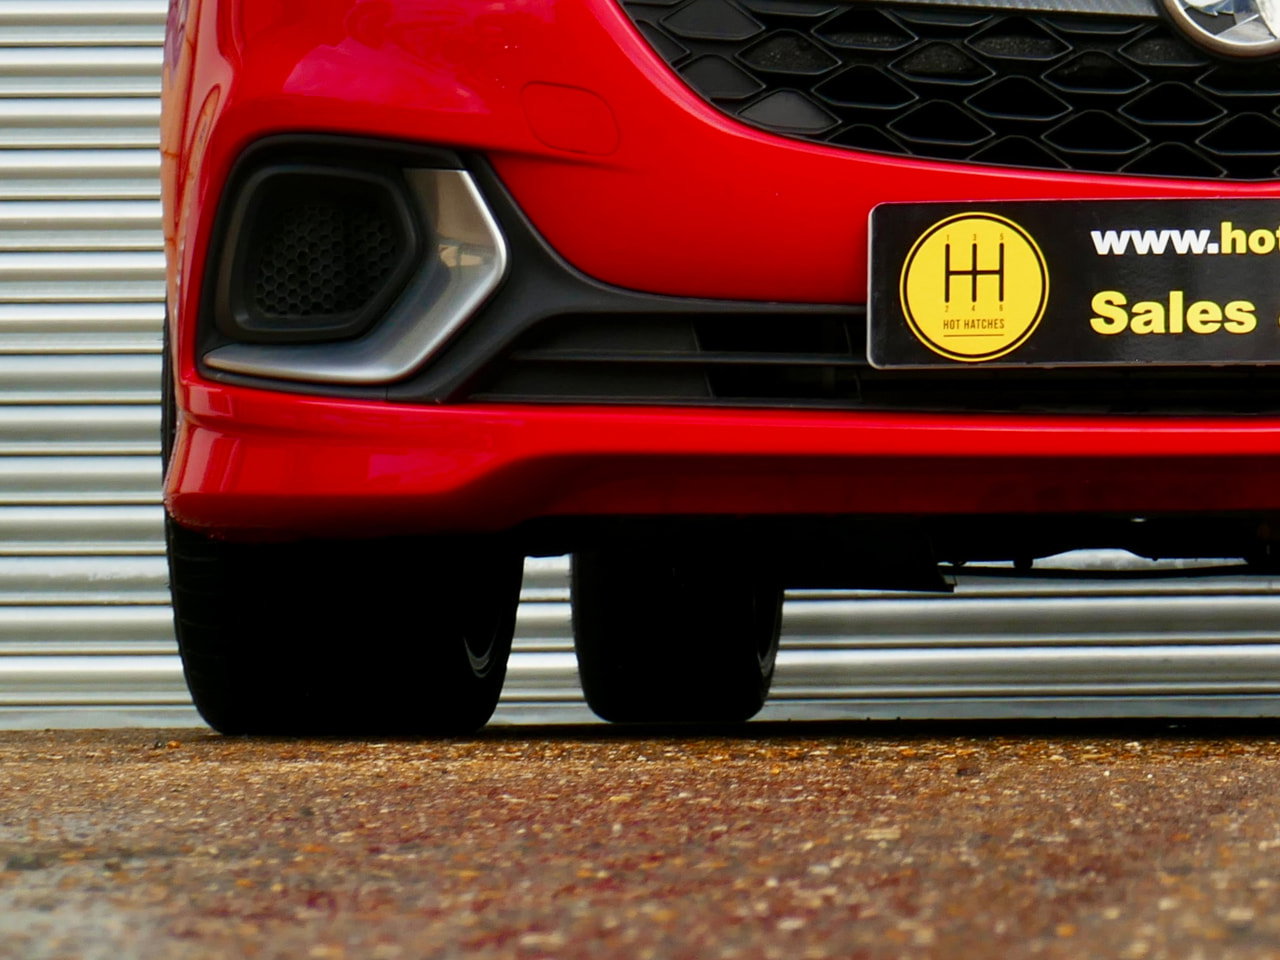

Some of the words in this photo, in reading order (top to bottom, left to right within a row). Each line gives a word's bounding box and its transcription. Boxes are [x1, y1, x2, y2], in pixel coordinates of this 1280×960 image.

[943, 319, 961, 330] HOT
[963, 318, 1005, 330] HATCHES
[1089, 290, 1257, 335] Sales
